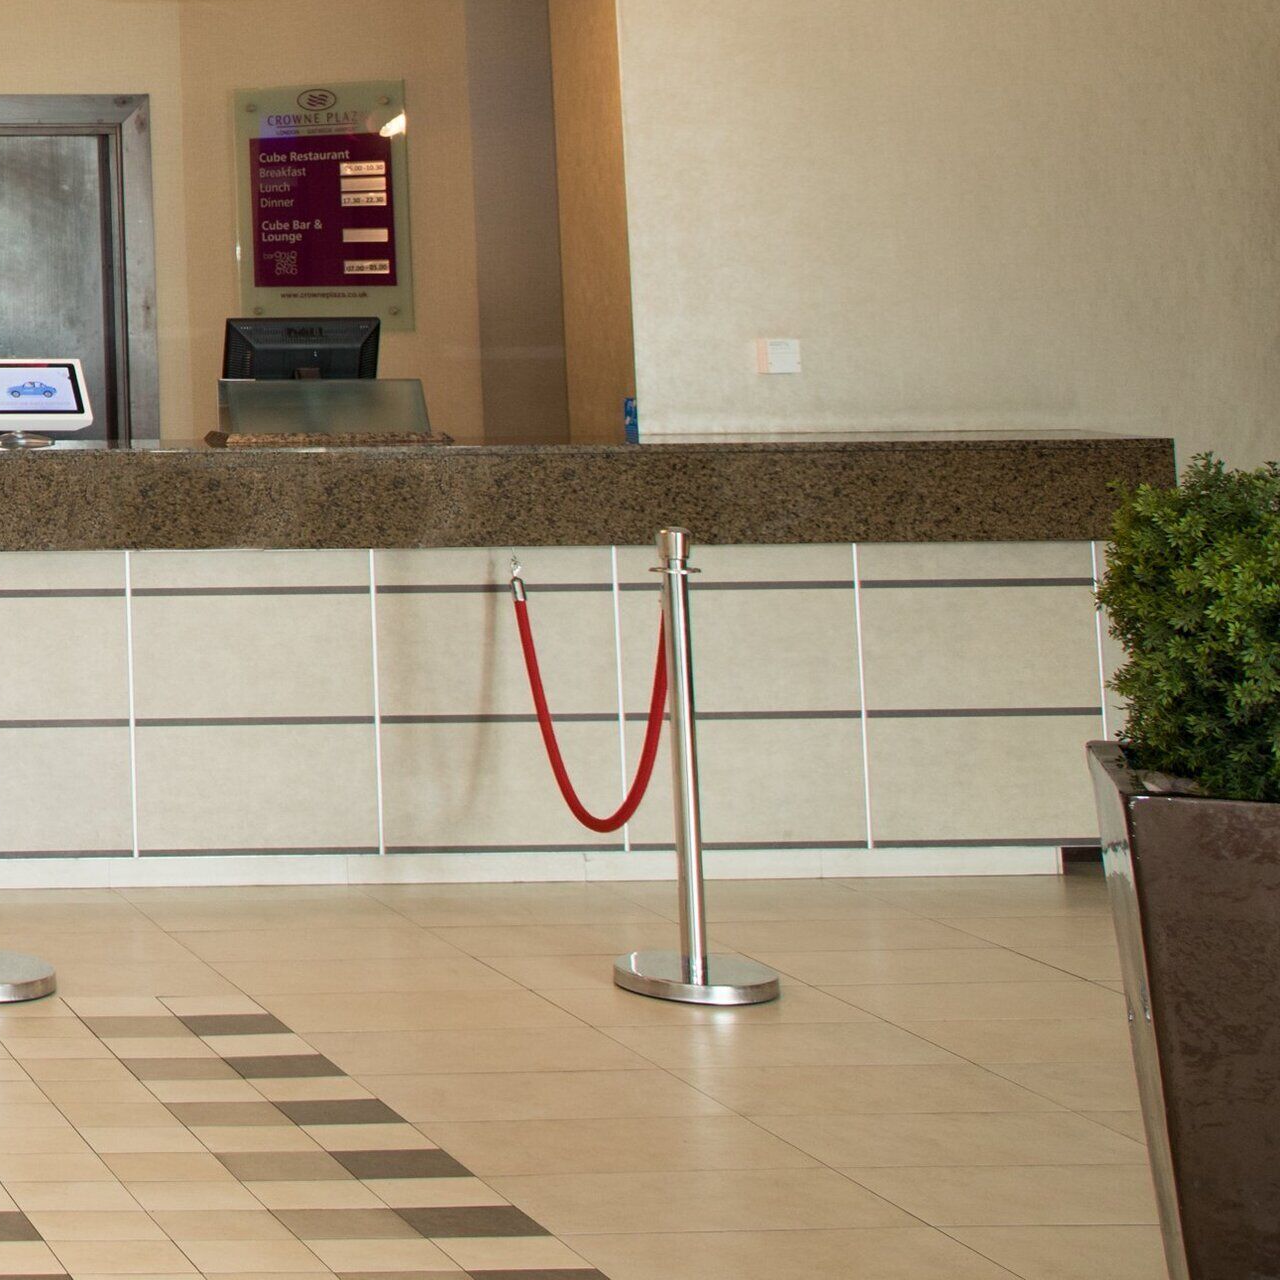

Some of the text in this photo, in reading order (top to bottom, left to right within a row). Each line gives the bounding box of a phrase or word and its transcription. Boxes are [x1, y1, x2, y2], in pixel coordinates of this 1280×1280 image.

[267, 111, 367, 126] CROWNE PLAZ
[259, 150, 350, 163] Cube Restaurant
[259, 167, 306, 178] Breakfast
[260, 182, 291, 193] Lunch
[260, 197, 295, 208] Dinner
[261, 219, 323, 231] Cube Bar &
[262, 232, 303, 244] Lounge
[280, 291, 368, 299] www.crowneplaza.co.uk
